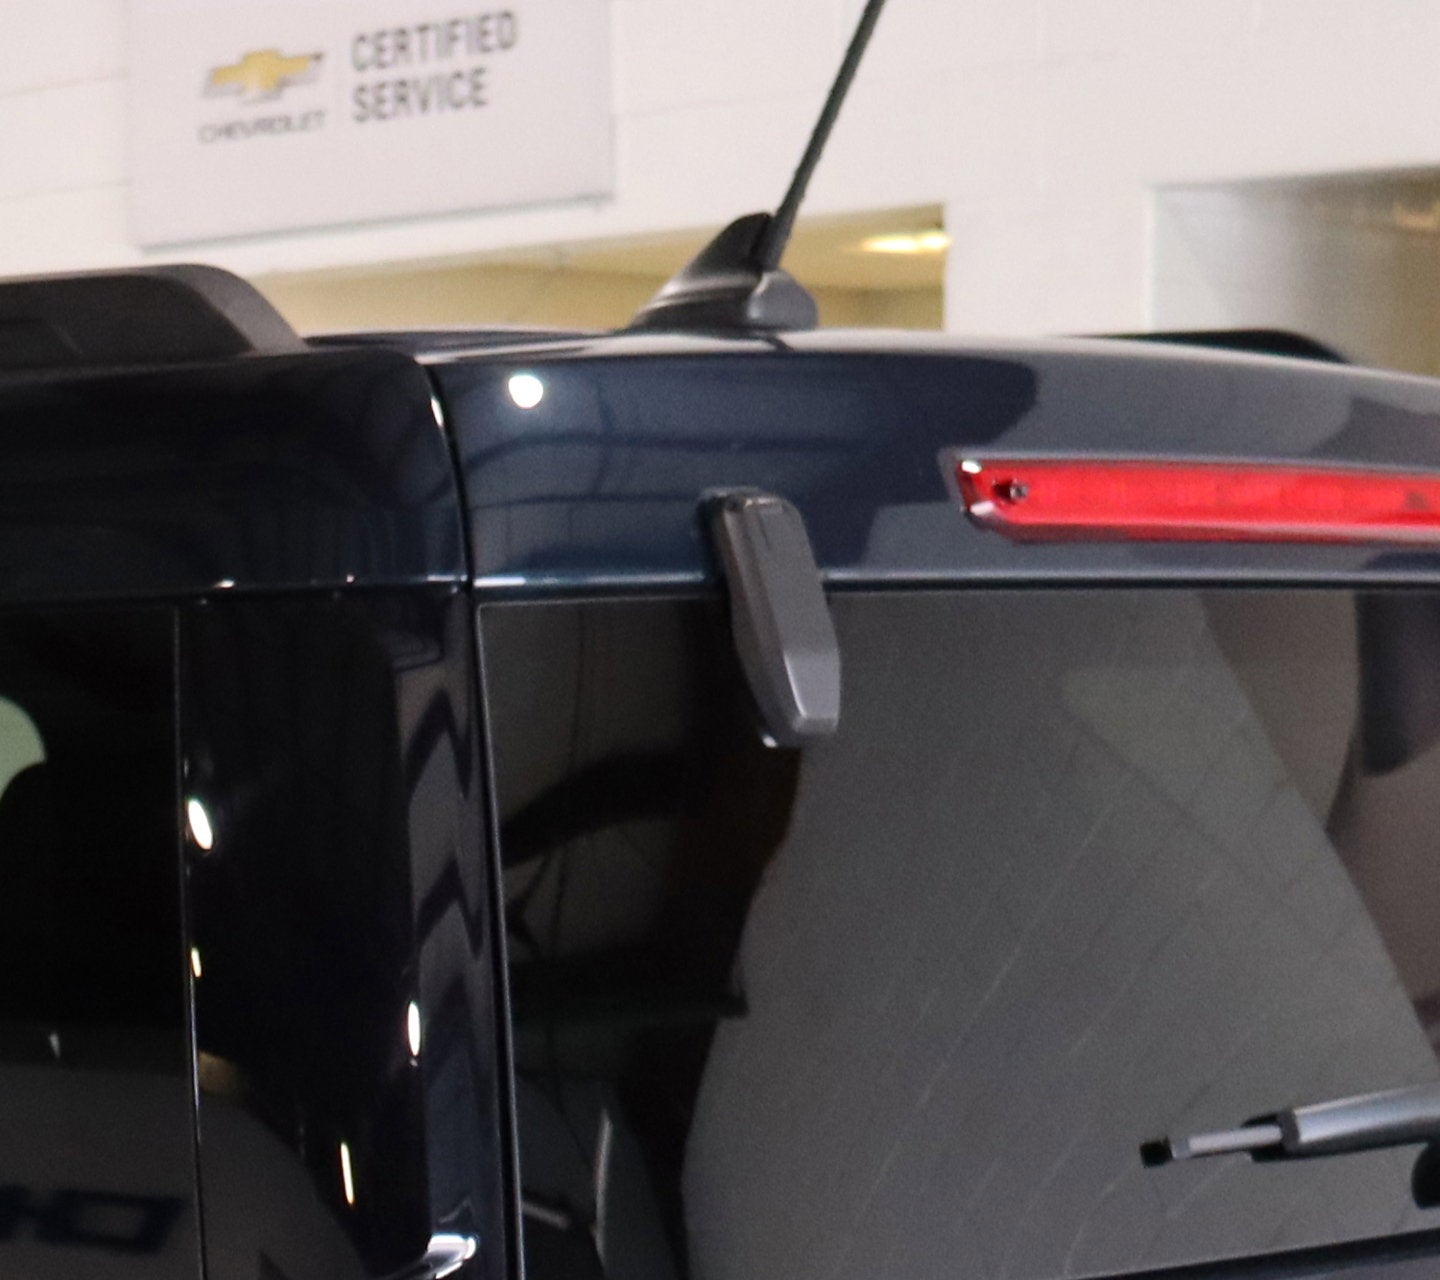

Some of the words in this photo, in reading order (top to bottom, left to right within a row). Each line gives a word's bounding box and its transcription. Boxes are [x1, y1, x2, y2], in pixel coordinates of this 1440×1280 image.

[350, 10, 518, 72] CERTIFIED
[352, 67, 489, 123] SERVICE
[198, 109, 326, 144] CHEVROLET
